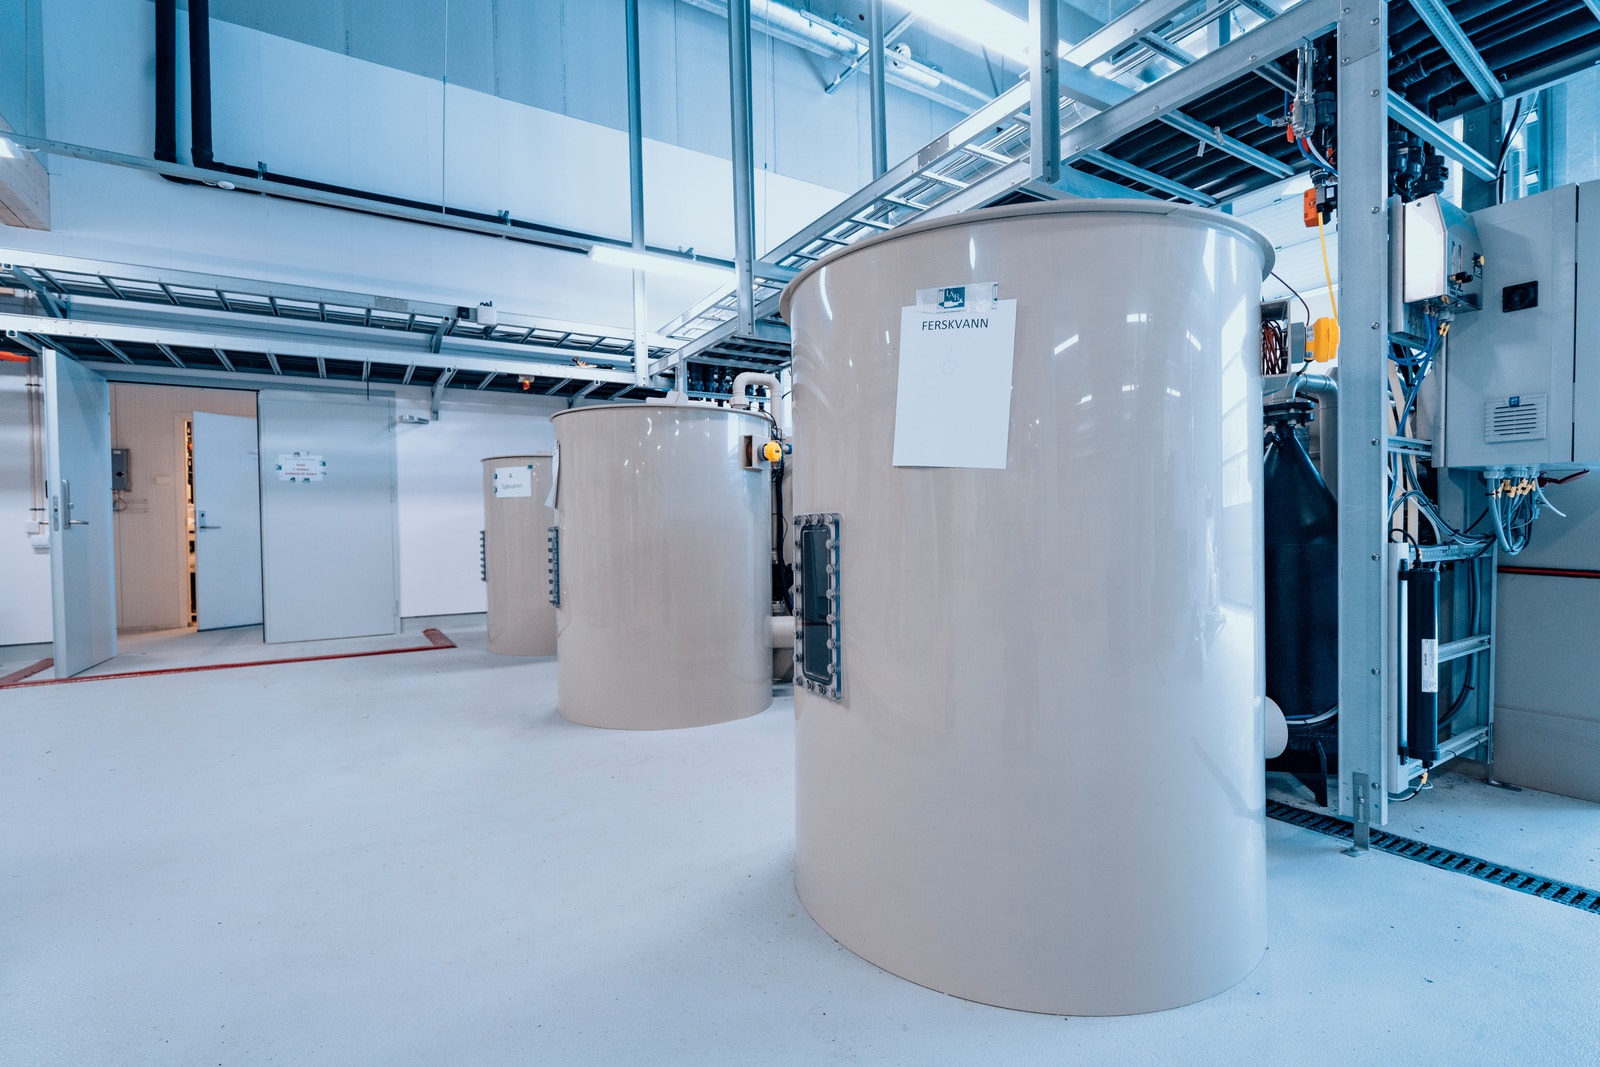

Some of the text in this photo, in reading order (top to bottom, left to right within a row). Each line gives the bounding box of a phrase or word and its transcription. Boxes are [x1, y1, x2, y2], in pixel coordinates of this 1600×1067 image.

[922, 318, 989, 331] FERSKVANN
[942, 344, 957, 376] 6
[501, 483, 523, 491] Sjøvann
